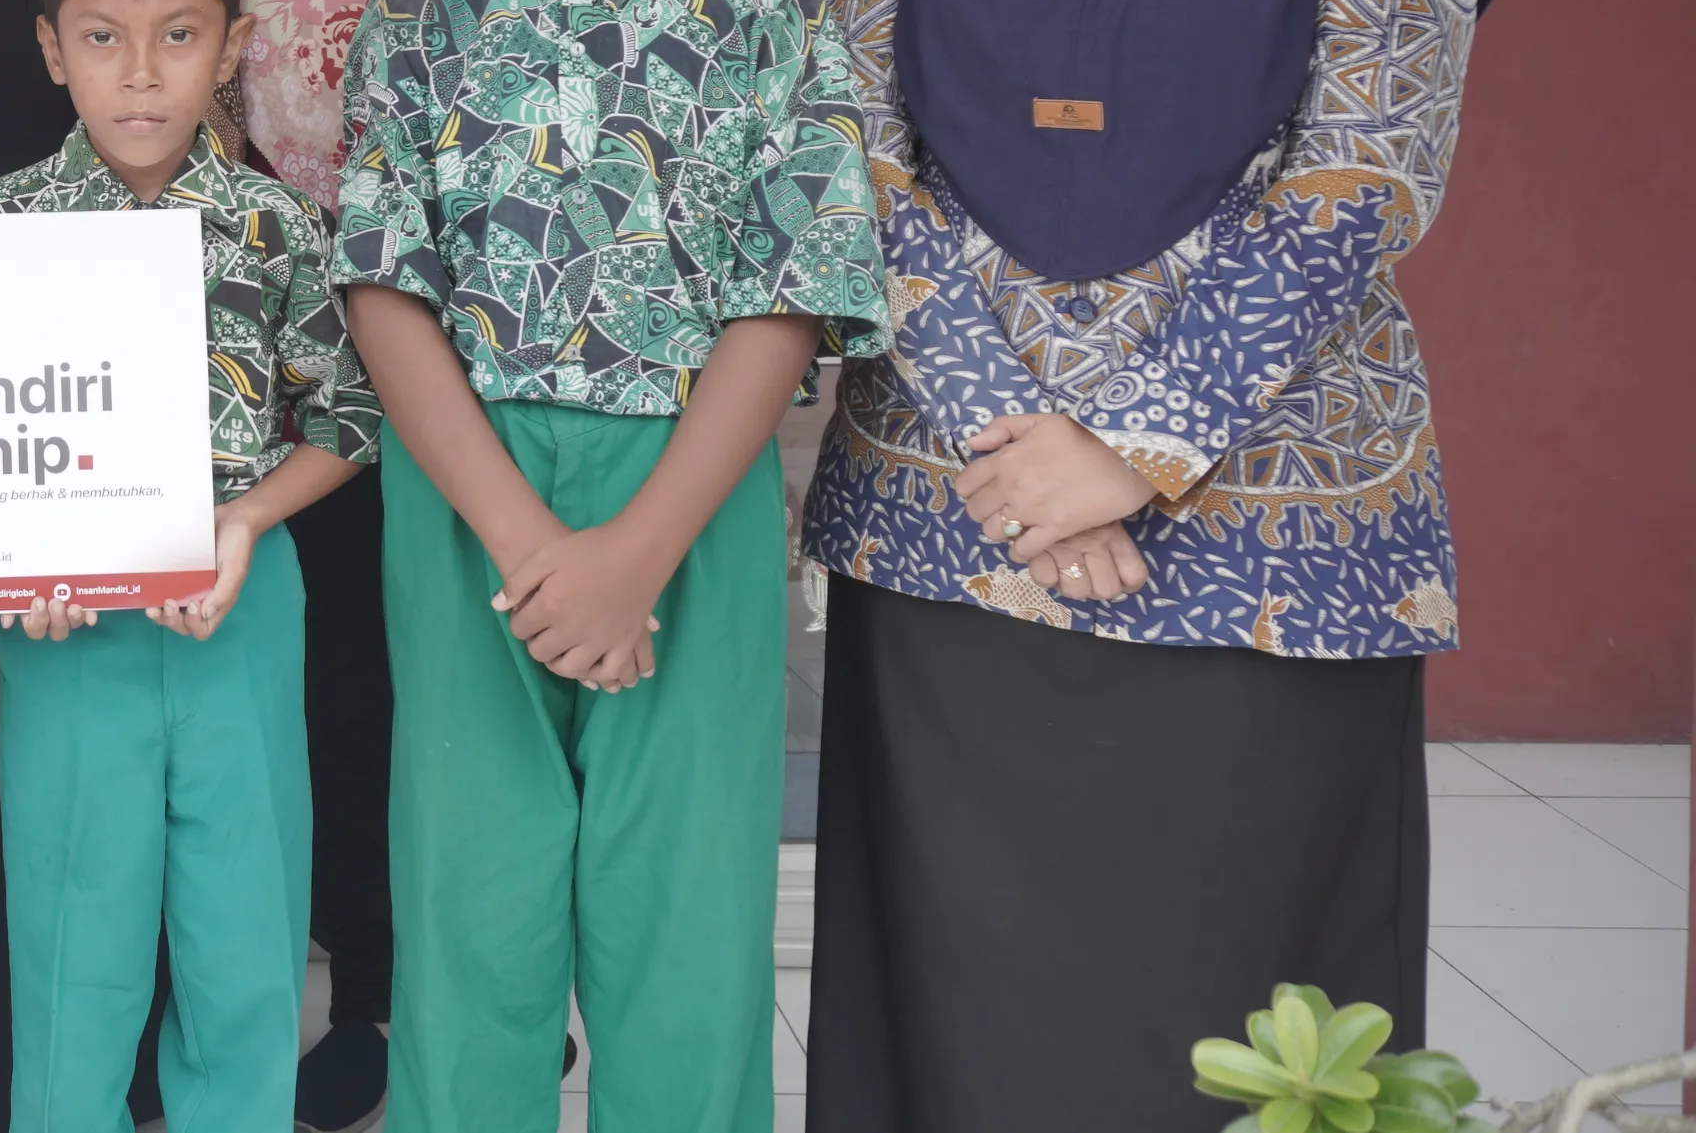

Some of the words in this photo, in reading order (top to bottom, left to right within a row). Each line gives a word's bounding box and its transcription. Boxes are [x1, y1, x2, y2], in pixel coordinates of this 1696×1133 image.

[219, 428, 254, 444] UKS
[10, 488, 55, 501] berhak
[57, 488, 67, 499] &
[70, 485, 164, 500] membutuhkan,
